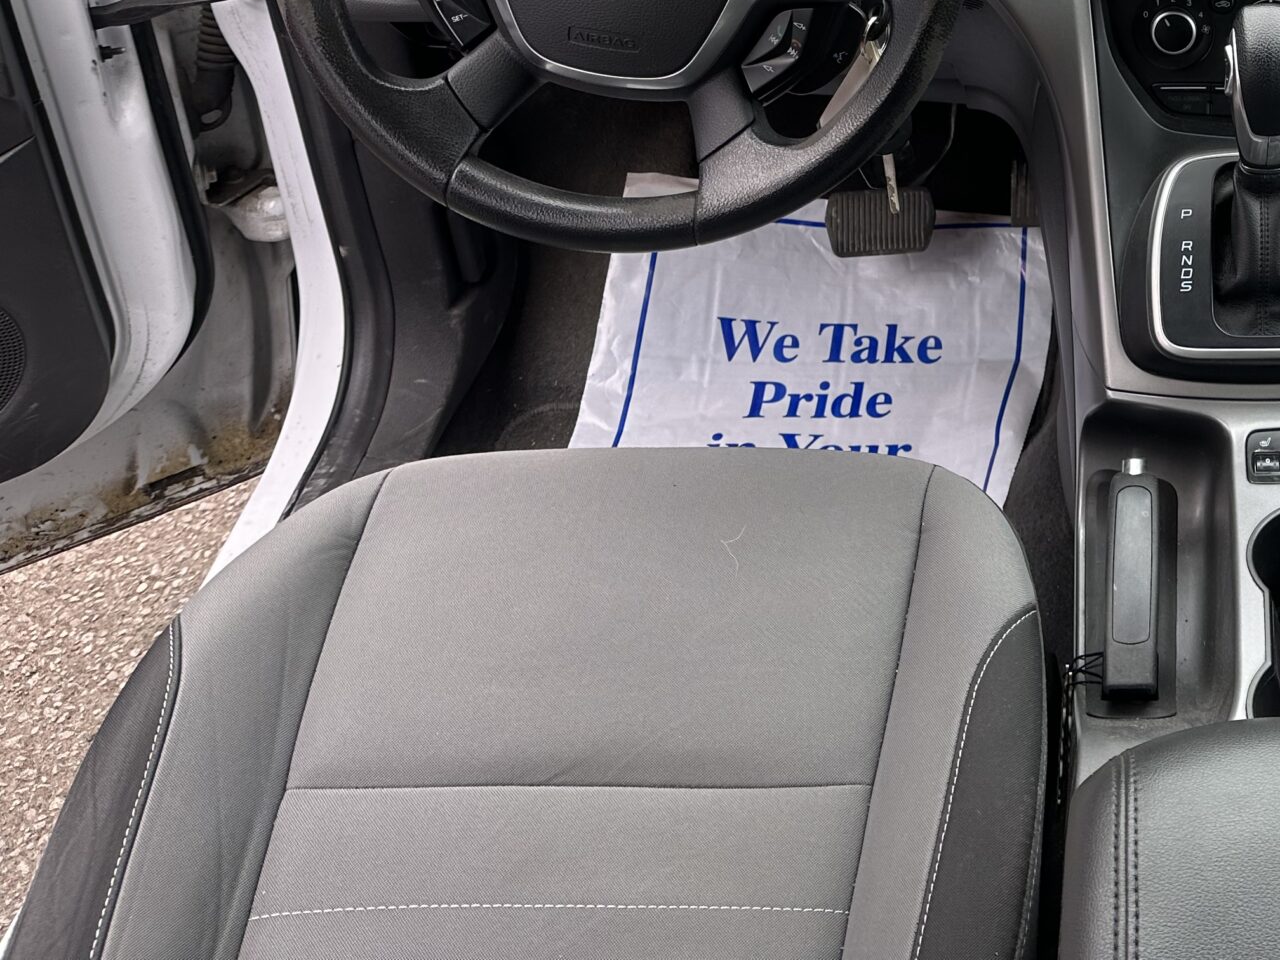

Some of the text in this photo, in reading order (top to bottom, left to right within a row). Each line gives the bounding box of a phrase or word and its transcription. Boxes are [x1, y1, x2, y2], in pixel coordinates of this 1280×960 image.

[1186, 0, 1192, 7] 3
[1181, 209, 1192, 219] P
[1181, 240, 1193, 252] R
[1181, 255, 1193, 266] N
[1180, 268, 1193, 279] D
[1180, 281, 1193, 292] S
[717, 316, 943, 365] We Take
[742, 380, 893, 420] Pride
